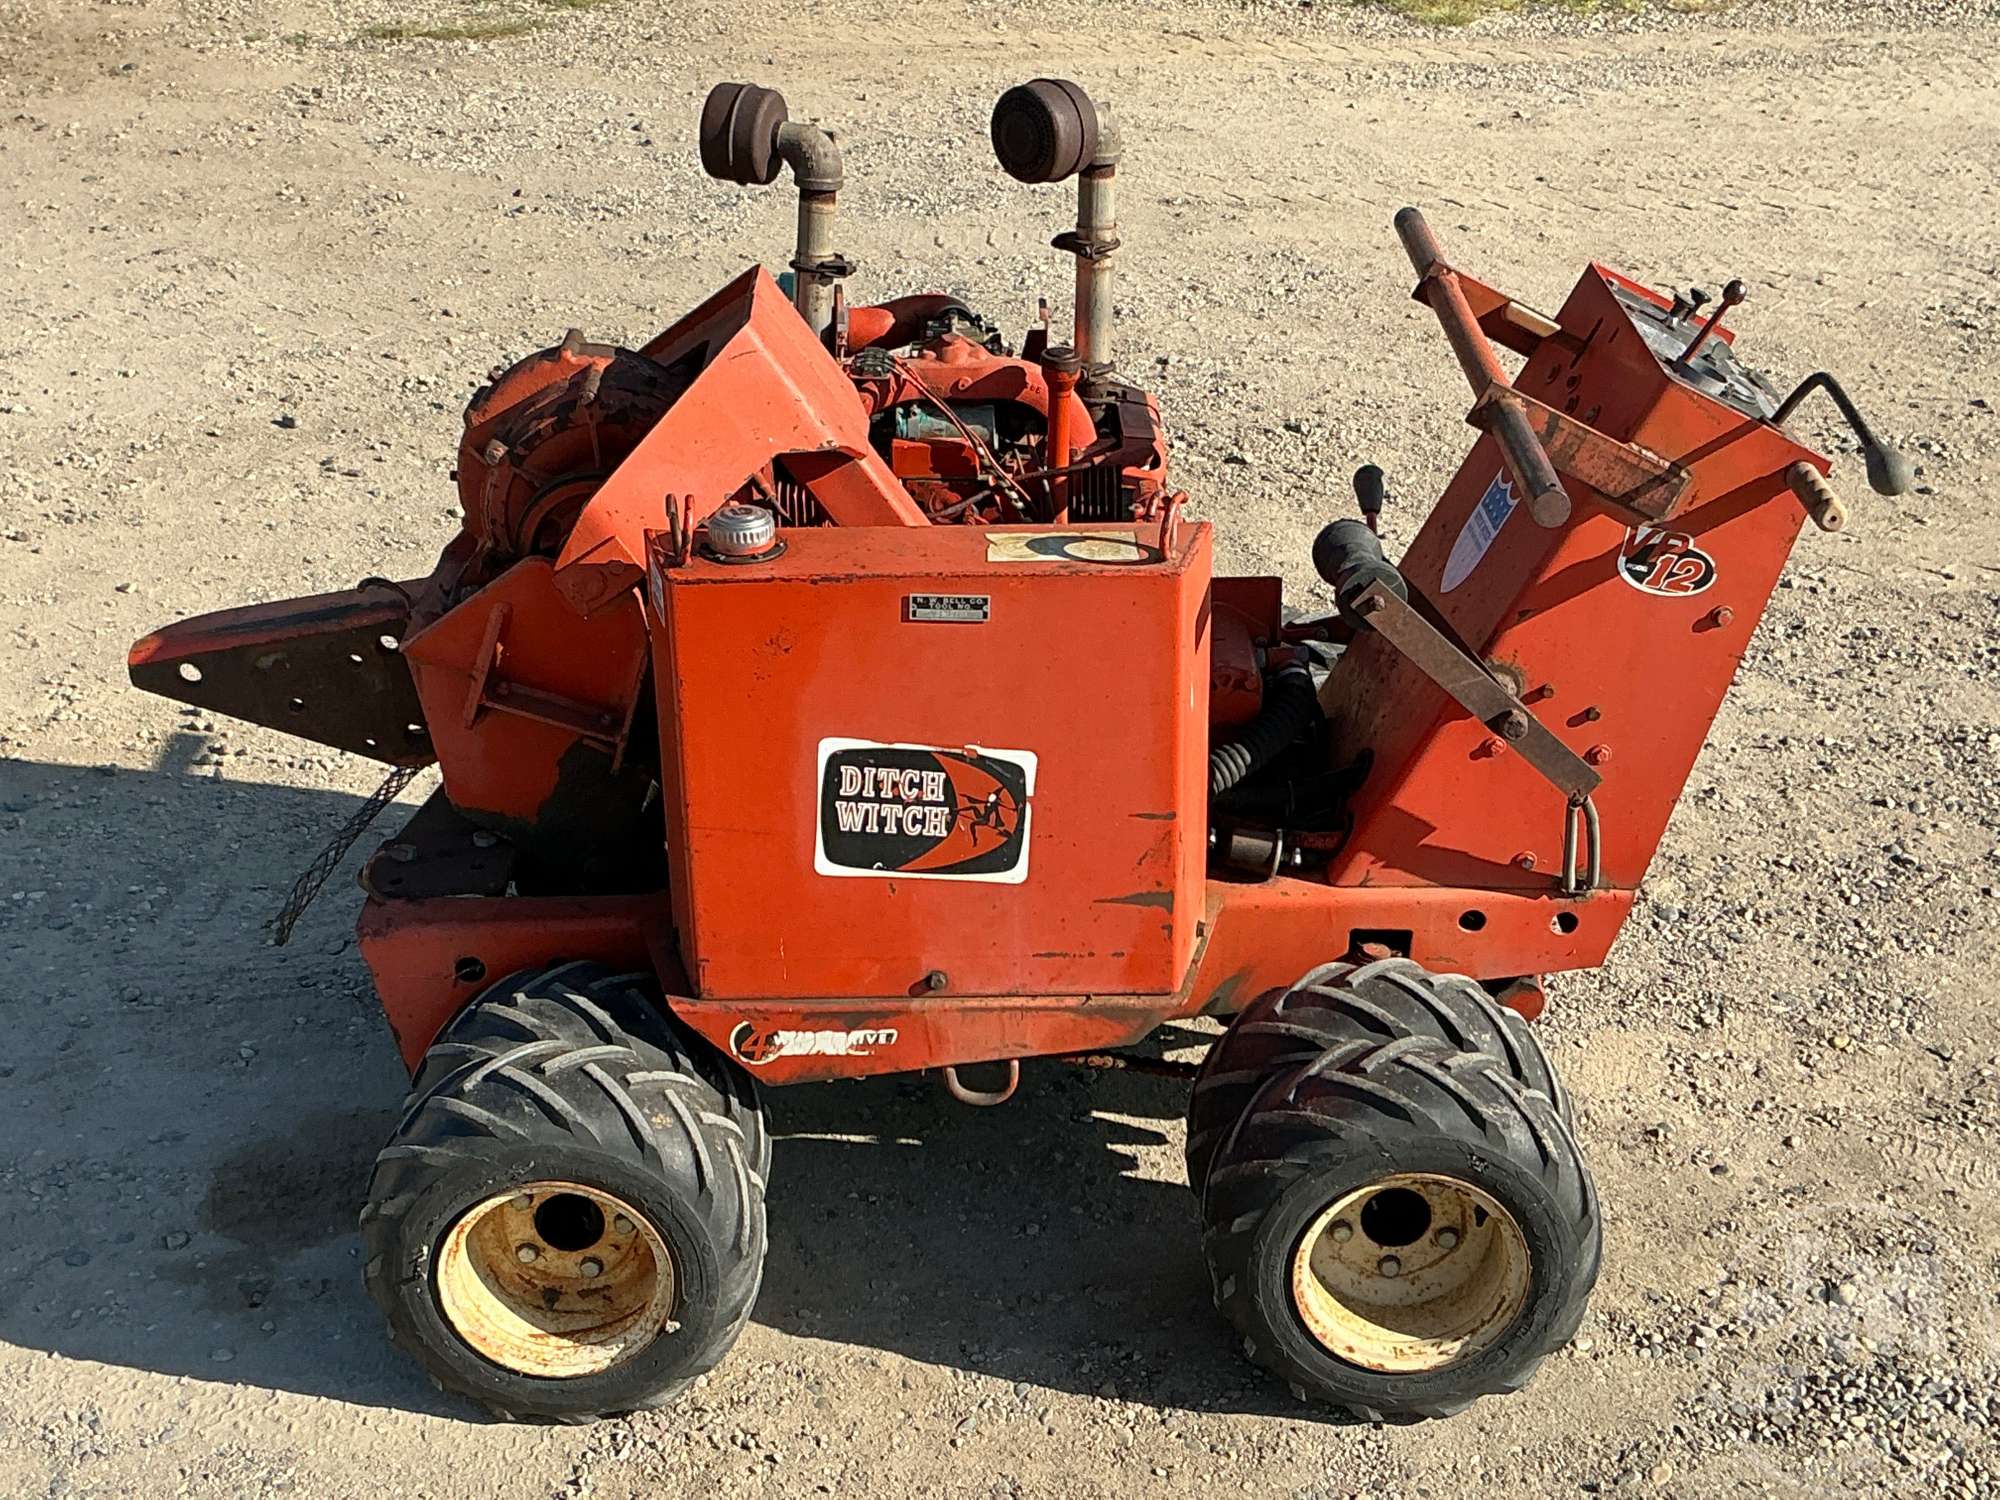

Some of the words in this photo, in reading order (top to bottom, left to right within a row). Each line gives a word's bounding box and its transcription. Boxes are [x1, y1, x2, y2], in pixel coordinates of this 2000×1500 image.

[1623, 526, 1690, 562] VP
[1642, 554, 1706, 593] 12
[943, 597, 966, 605] BELL
[839, 765, 947, 802] DITCH
[835, 801, 951, 838] WITCH
[741, 1022, 767, 1060] 4
